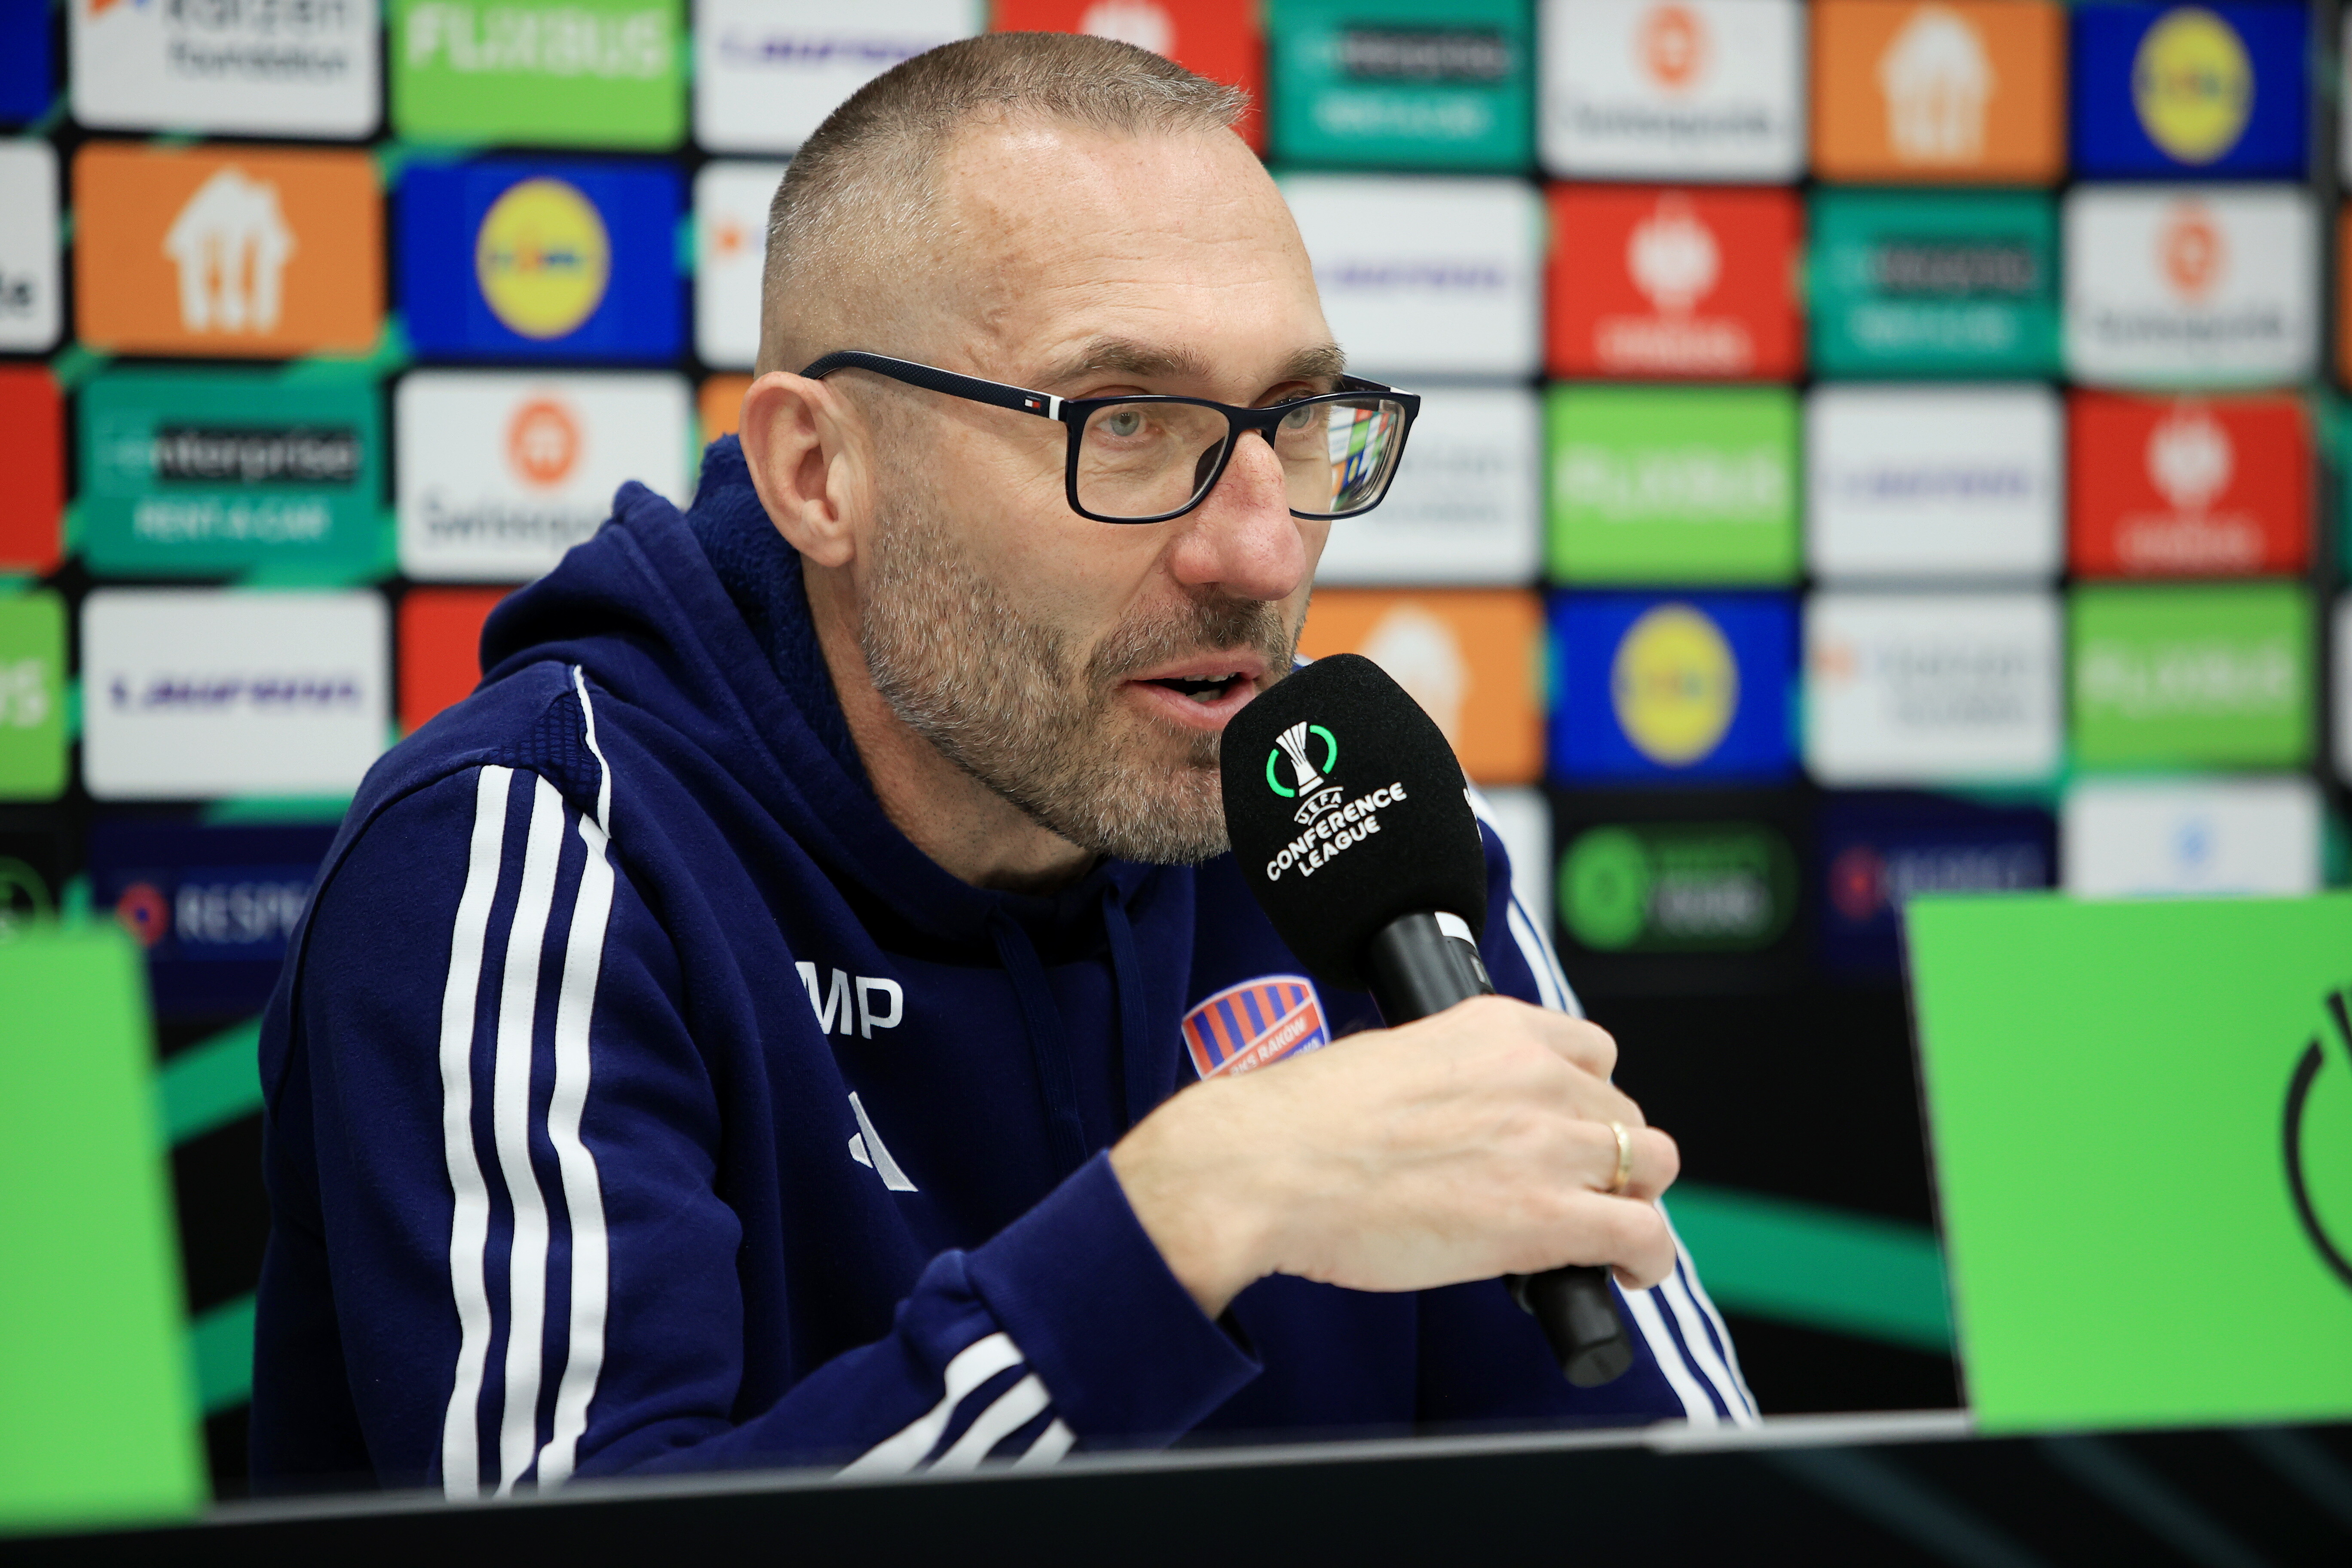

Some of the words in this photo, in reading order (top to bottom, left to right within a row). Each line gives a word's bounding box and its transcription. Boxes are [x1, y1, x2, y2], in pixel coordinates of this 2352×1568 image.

[1267, 782, 1407, 881] CONFERENCE
[1298, 792, 1341, 825] UEFA
[1298, 815, 1381, 877] LEAGUE
[795, 961, 903, 1039] MP
